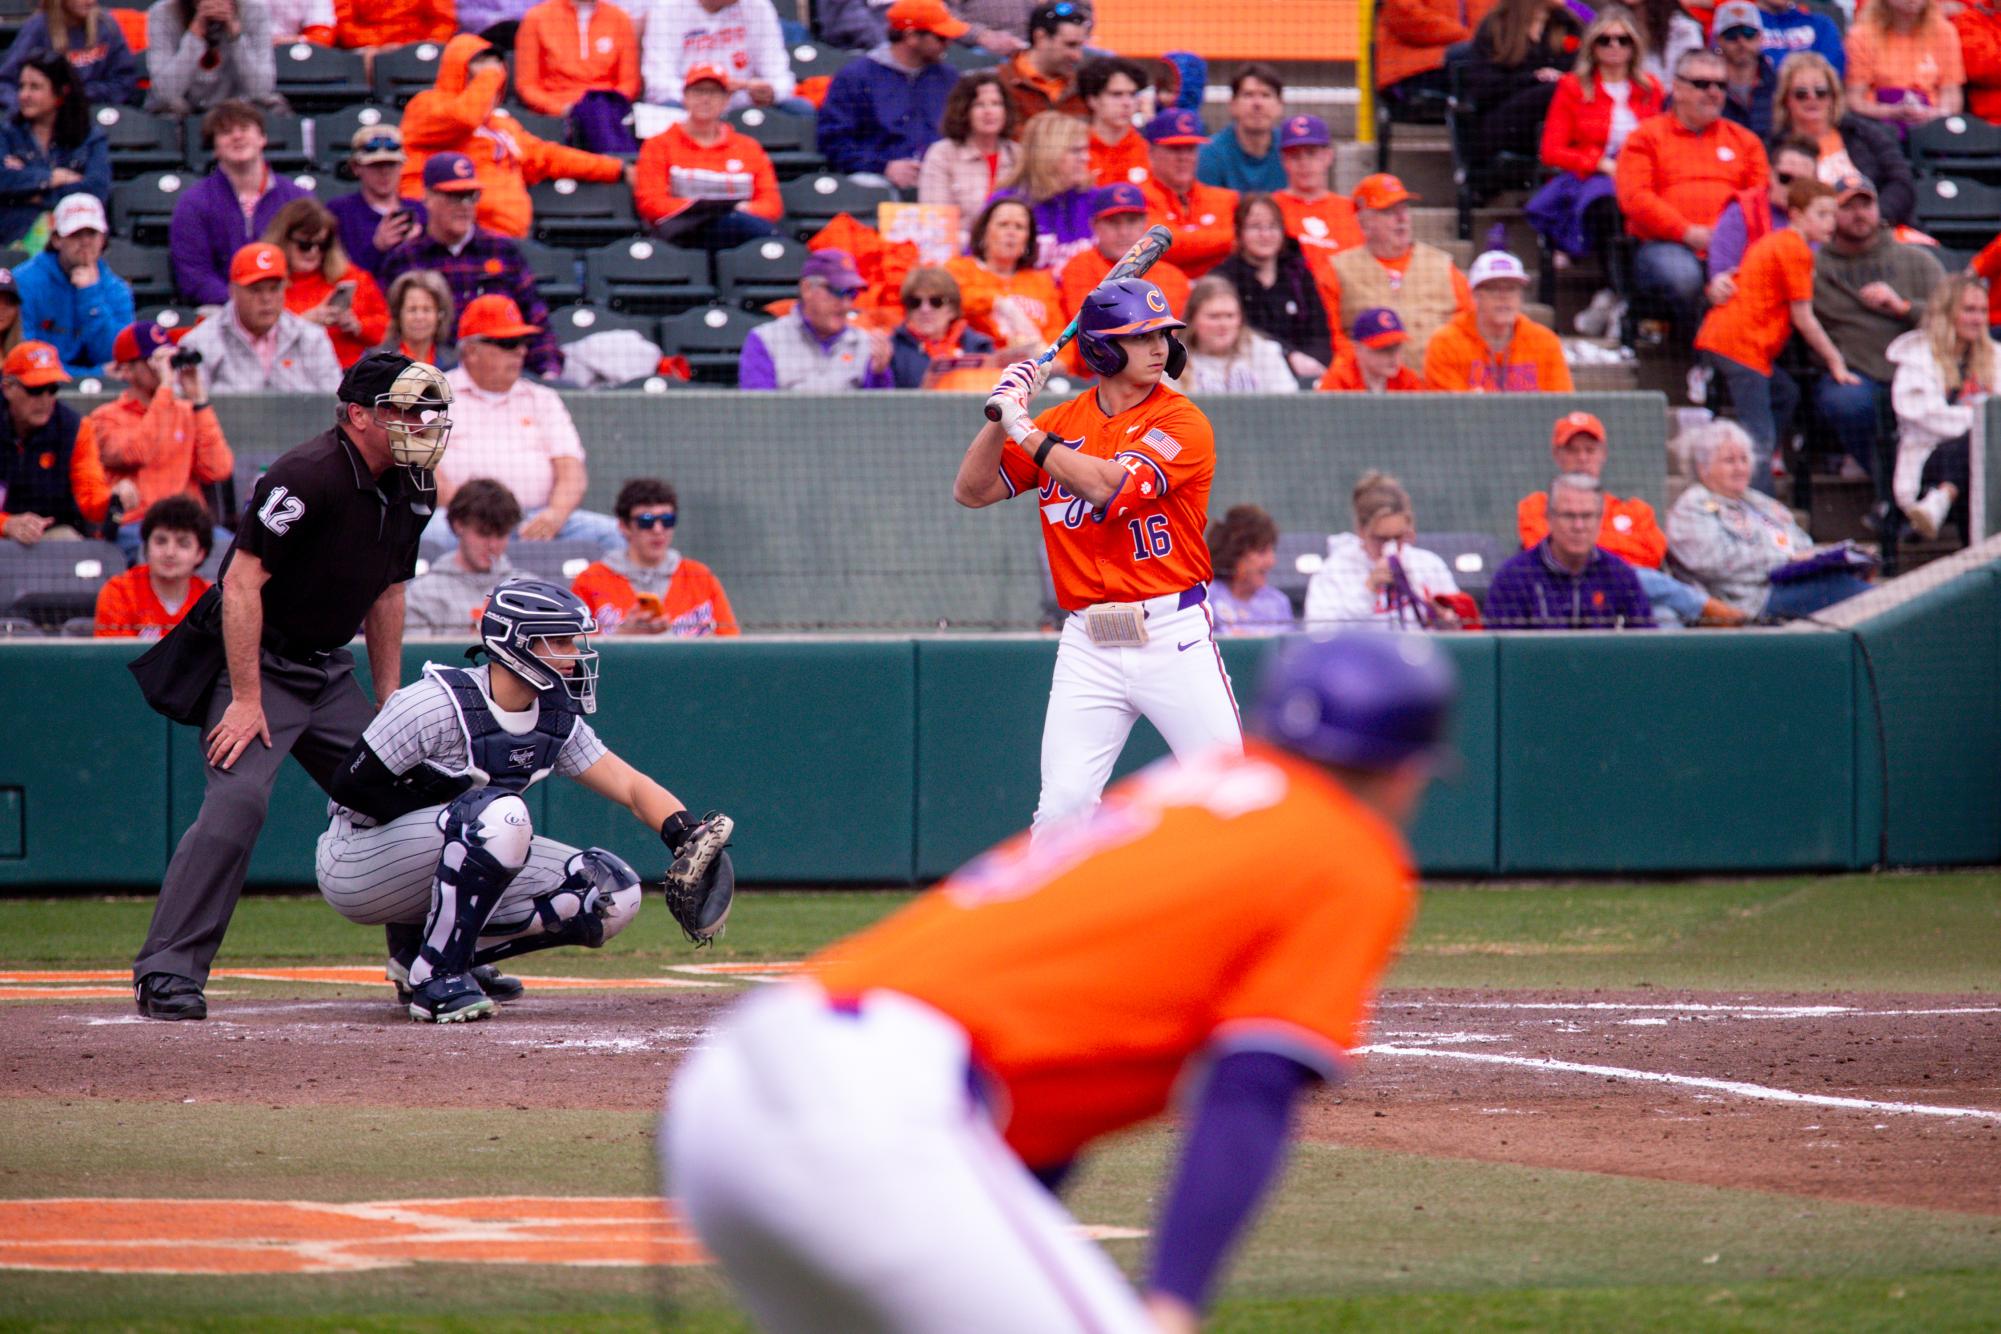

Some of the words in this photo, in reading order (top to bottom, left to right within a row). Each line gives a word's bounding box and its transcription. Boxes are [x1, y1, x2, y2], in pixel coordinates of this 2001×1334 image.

[256, 251, 274, 270] C
[1147, 290, 1165, 312] C
[257, 486, 305, 536] 12
[1128, 513, 1172, 561] 16
